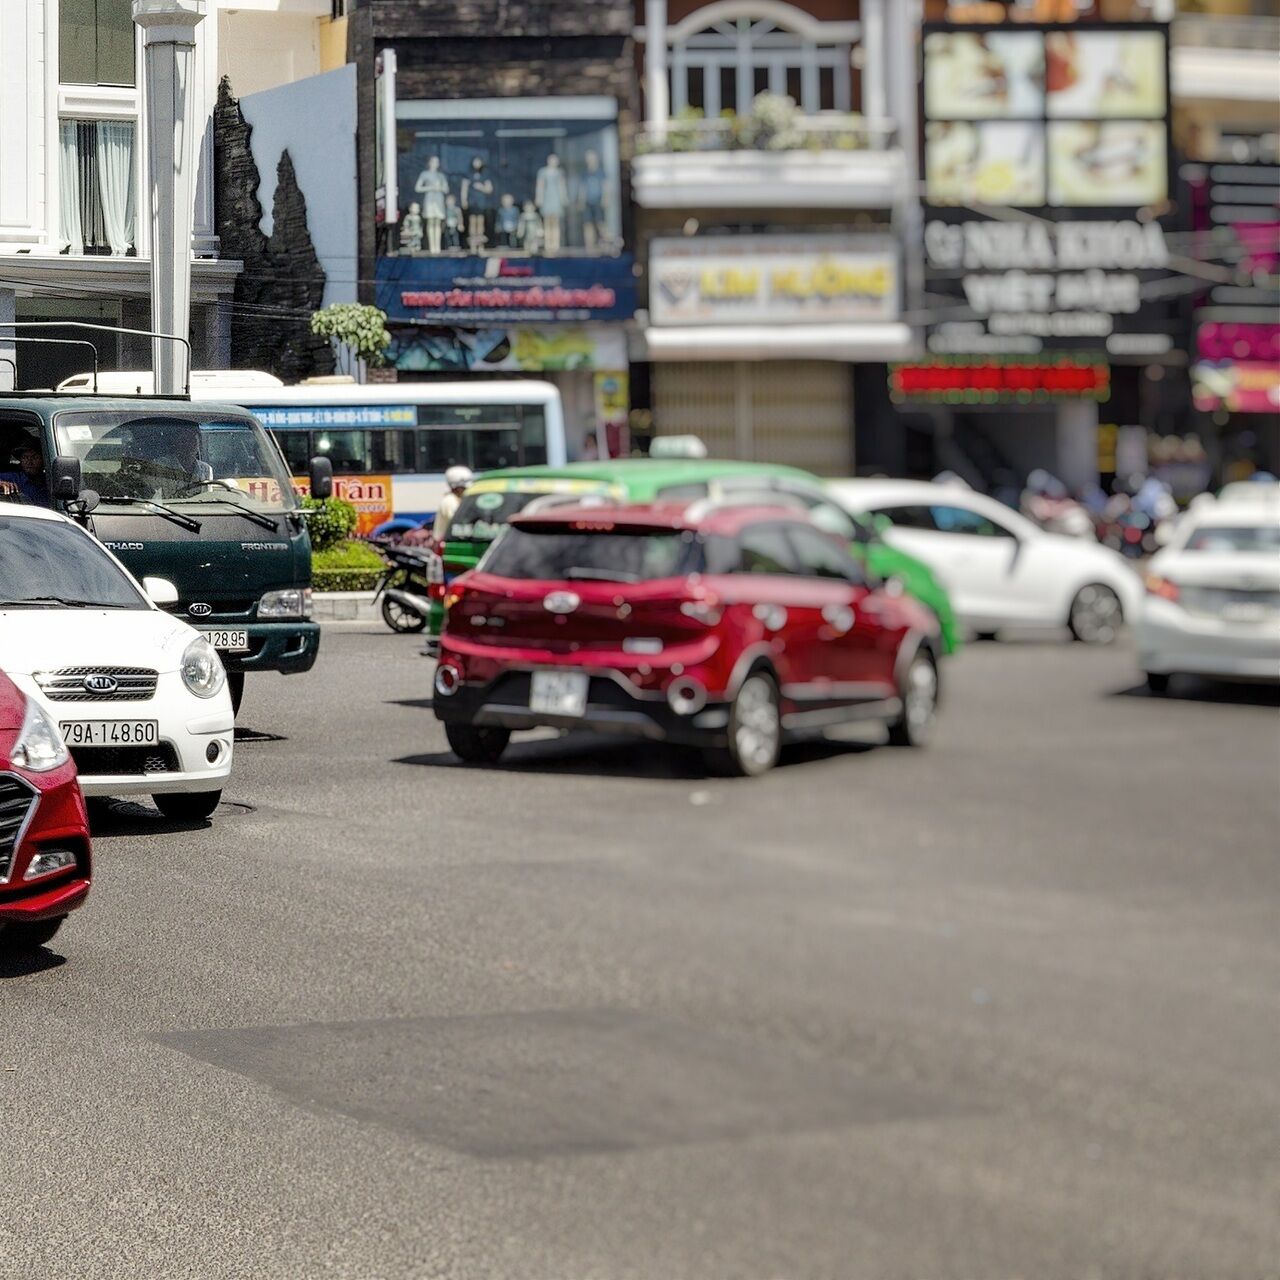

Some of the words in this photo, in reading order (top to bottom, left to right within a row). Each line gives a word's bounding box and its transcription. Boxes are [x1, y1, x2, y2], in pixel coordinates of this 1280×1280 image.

[105, 542, 144, 551] THACO
[241, 542, 289, 551] FRONTIER
[207, 631, 246, 647] 128.95
